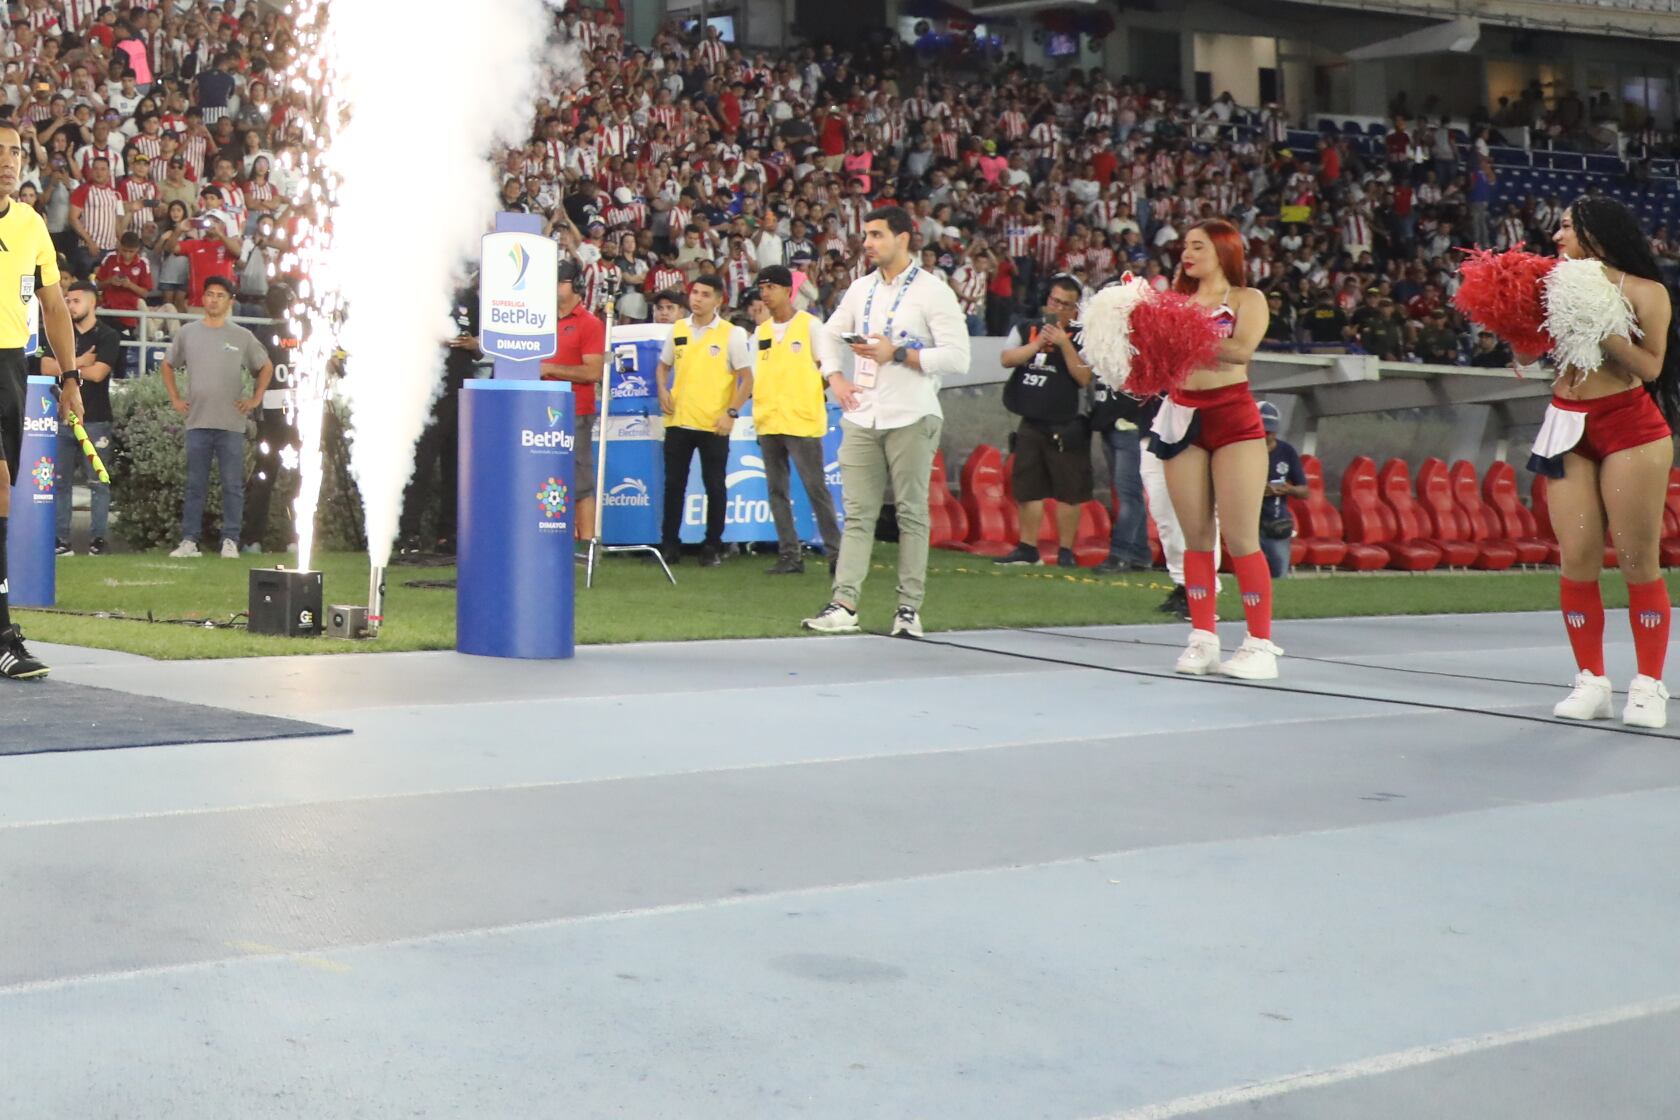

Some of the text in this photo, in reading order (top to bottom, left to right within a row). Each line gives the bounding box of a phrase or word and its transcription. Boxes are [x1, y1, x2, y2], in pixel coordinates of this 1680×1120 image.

[491, 299, 526, 308] SUPERLIGA
[491, 307, 547, 329] BetPlay
[496, 339, 541, 351] DIMAYOR
[1022, 372, 1048, 388] 297
[521, 429, 575, 452] BetPlay
[538, 521, 567, 530] DIMAYOR
